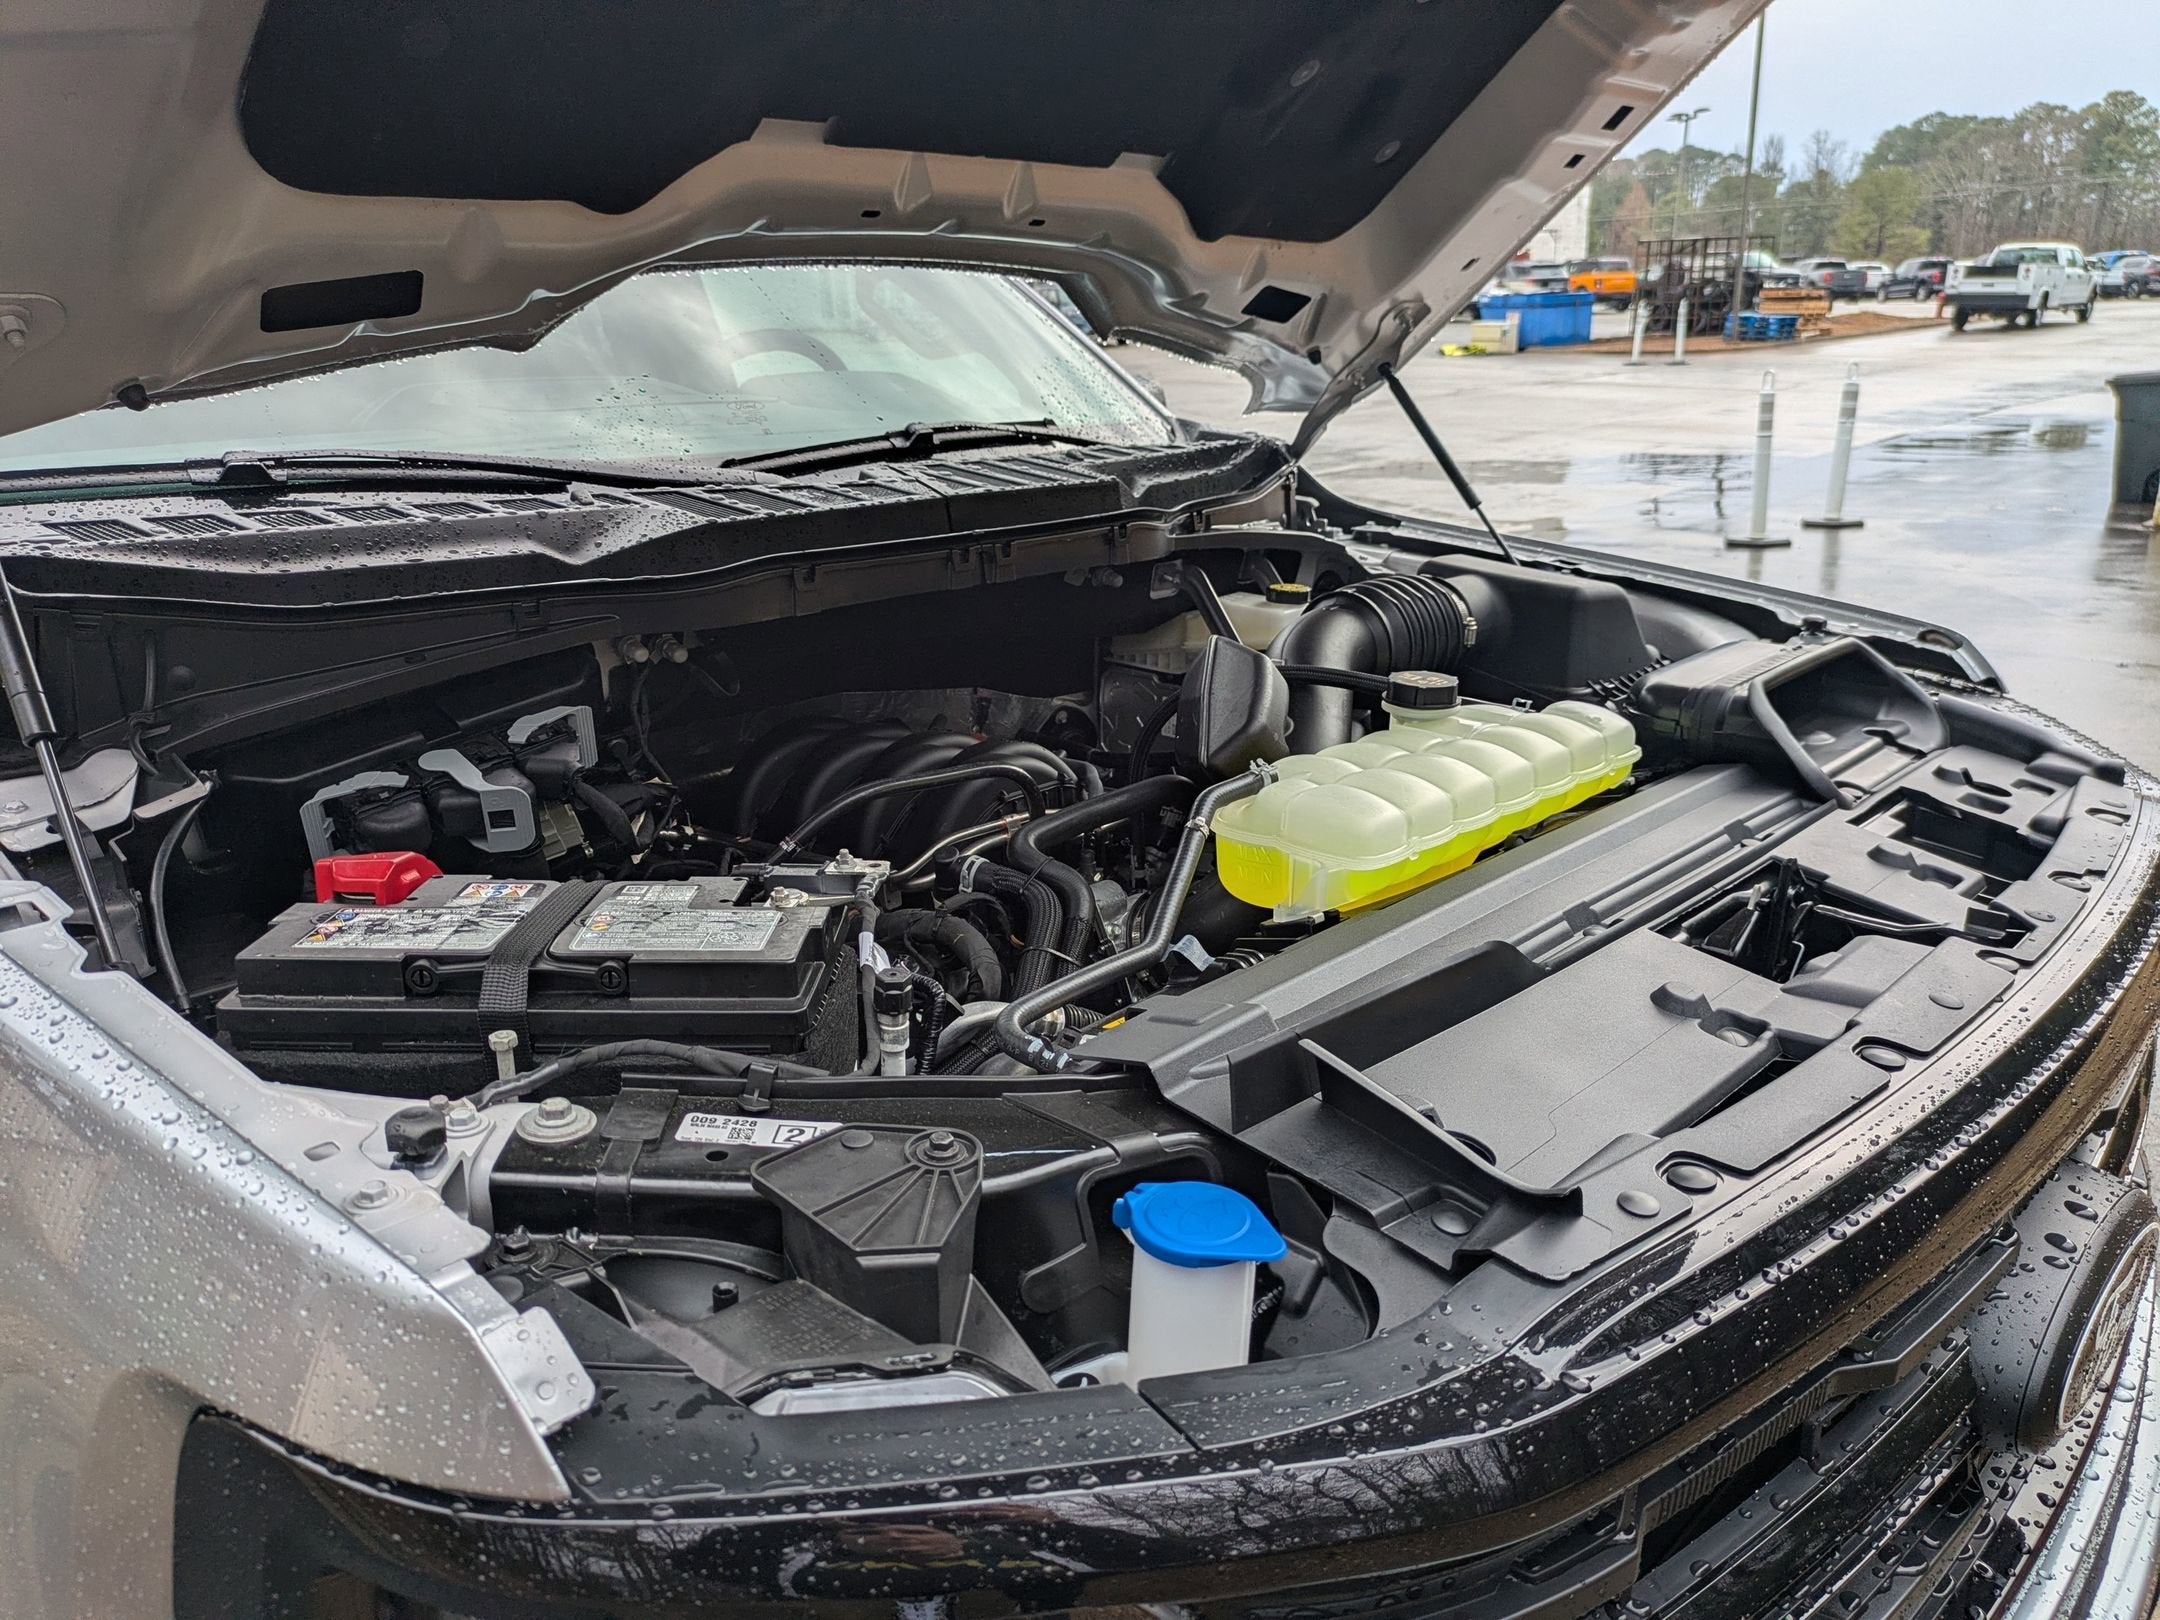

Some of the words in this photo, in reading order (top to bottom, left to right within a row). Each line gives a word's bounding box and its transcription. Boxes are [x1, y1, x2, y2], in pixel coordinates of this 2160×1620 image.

[1238, 843, 1272, 865] MAX
[1238, 865, 1273, 884] MIN
[690, 1115, 717, 1124] 009
[722, 1118, 758, 1127] 2428
[783, 1128, 806, 1143] 2
